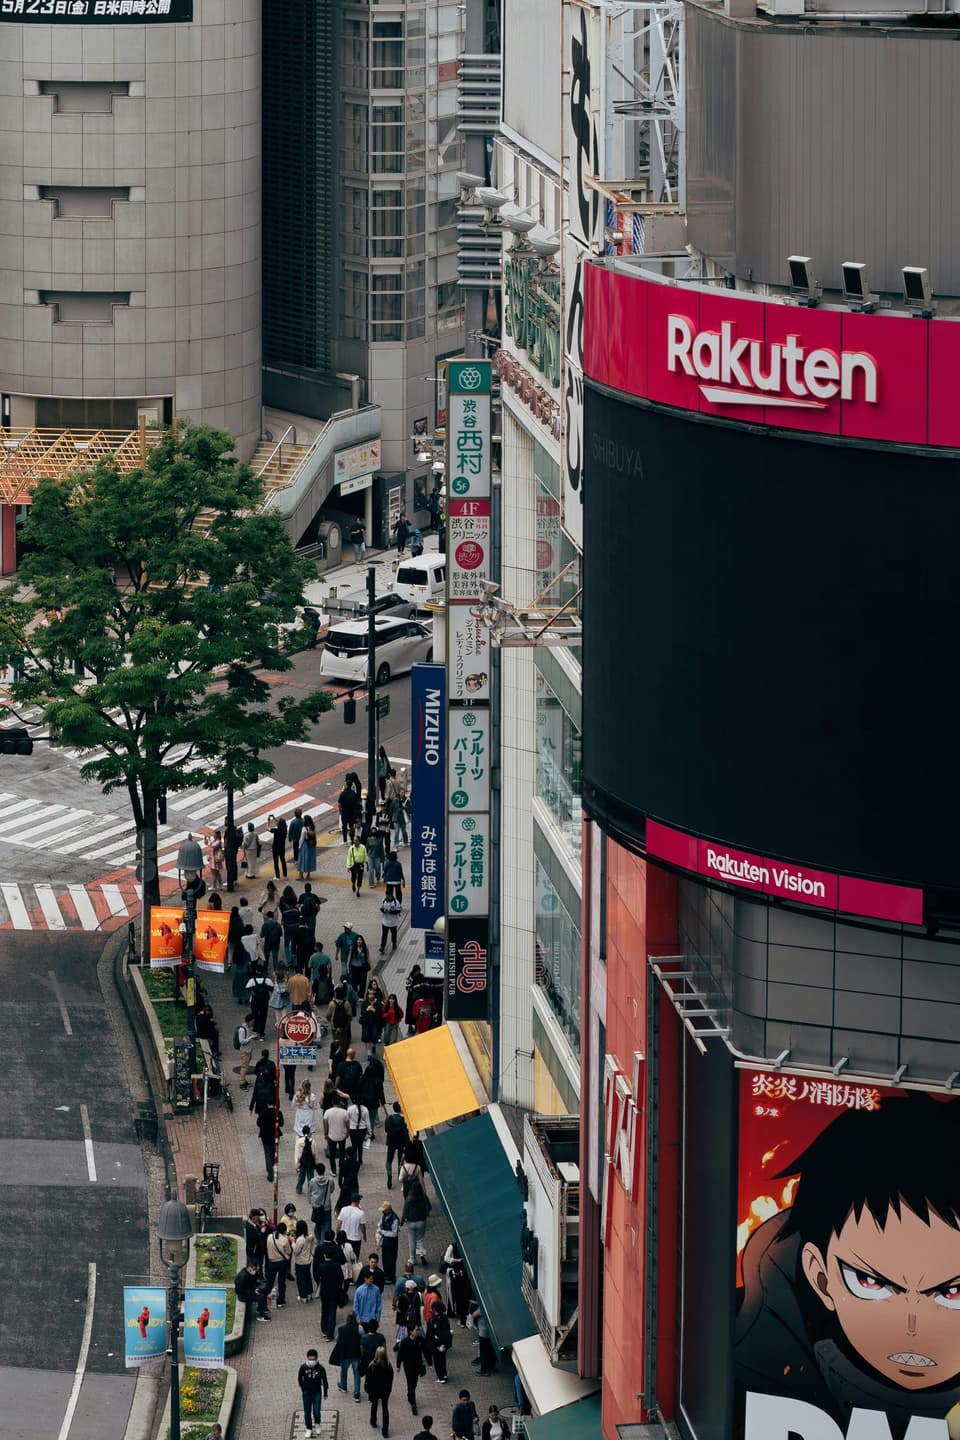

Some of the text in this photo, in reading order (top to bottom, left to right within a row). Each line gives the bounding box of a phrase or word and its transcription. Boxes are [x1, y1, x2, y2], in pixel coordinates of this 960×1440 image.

[667, 313, 878, 403] Rakuten
[456, 399, 483, 475] 渋谷西村
[455, 480, 467, 491] 5F
[451, 518, 474, 530] 渋谷
[460, 502, 480, 515] 4F
[451, 531, 488, 540] クリニック
[453, 572, 486, 580] 形成外科
[465, 619, 473, 656] ジャスミン
[425, 688, 441, 766] MIZUHO
[453, 737, 468, 788] パーラー
[470, 729, 484, 781] フルーツ
[454, 794, 466, 805] 2F
[421, 825, 437, 909] みずほ銀行
[453, 842, 467, 892] フルーツ
[470, 834, 484, 888] 渋谷西村
[707, 848, 825, 898] Rakuten Vision
[455, 899, 465, 909] 1F
[456, 940, 487, 994] HUB
[287, 1023, 310, 1035] 消火栓
[752, 1074, 881, 1111] 炎炎ノ消防隊
